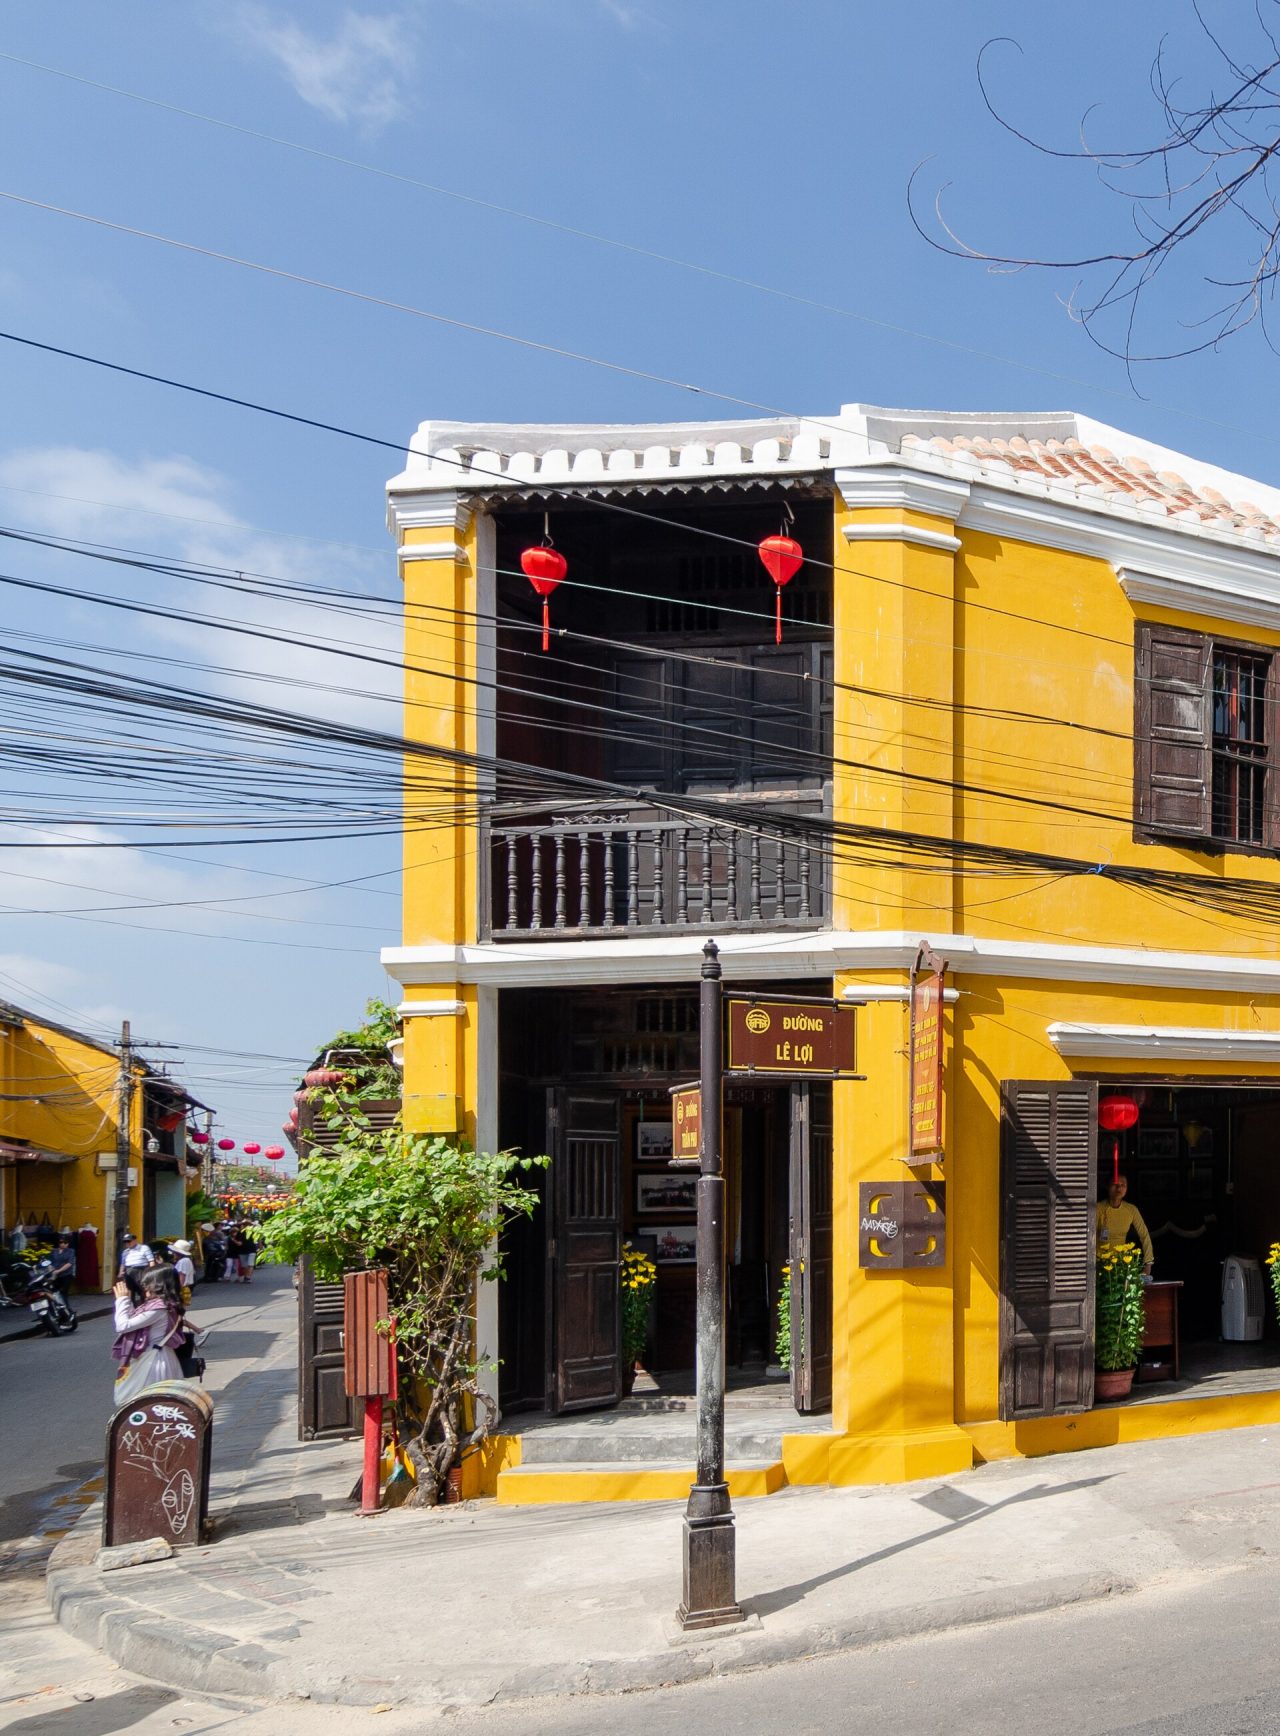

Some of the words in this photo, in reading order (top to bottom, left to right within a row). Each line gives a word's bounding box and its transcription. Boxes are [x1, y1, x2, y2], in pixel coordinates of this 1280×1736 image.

[783, 1013, 823, 1032] ĐƯỜNG
[776, 1041, 791, 1060] LÊ
[794, 1044, 813, 1065] LỢI
